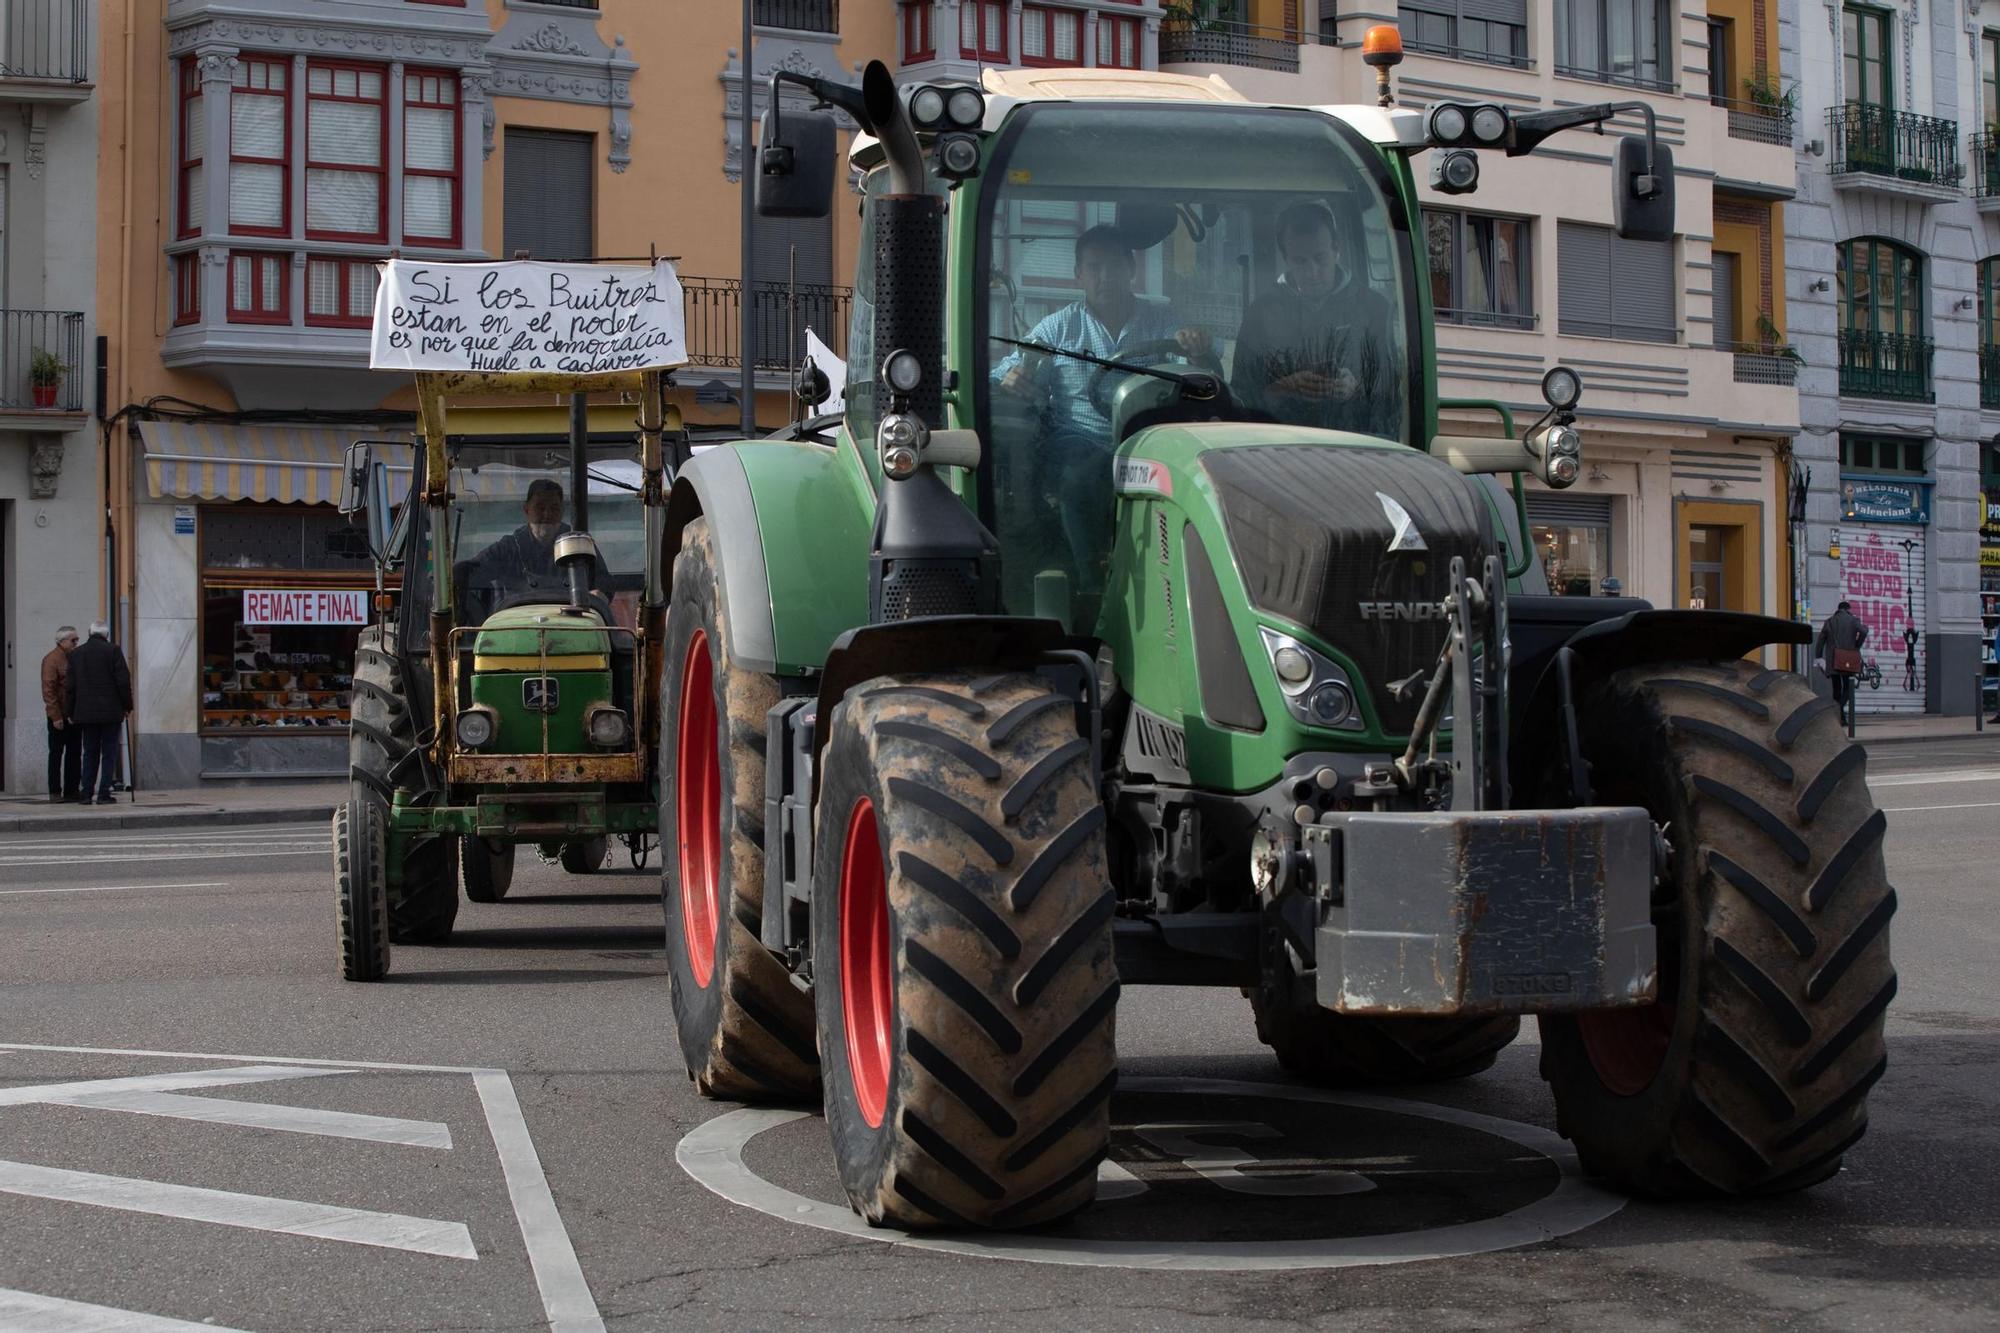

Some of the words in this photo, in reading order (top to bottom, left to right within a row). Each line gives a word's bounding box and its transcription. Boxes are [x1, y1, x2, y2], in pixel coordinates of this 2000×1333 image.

[409, 270, 459, 305] Si
[477, 271, 535, 309] los
[549, 273, 665, 310] Buitres
[391, 304, 467, 333] estan
[480, 314, 513, 334] en
[527, 311, 552, 332] el
[570, 307, 648, 341] poder
[389, 330, 412, 348] es
[421, 335, 457, 354] por
[508, 330, 537, 351] la
[471, 351, 521, 370] Huele
[529, 356, 546, 369] a
[35, 507, 48, 528] 6
[1854, 502, 1911, 517] Valenciana
[248, 593, 313, 622] REMATE
[317, 593, 363, 622] FINAL
